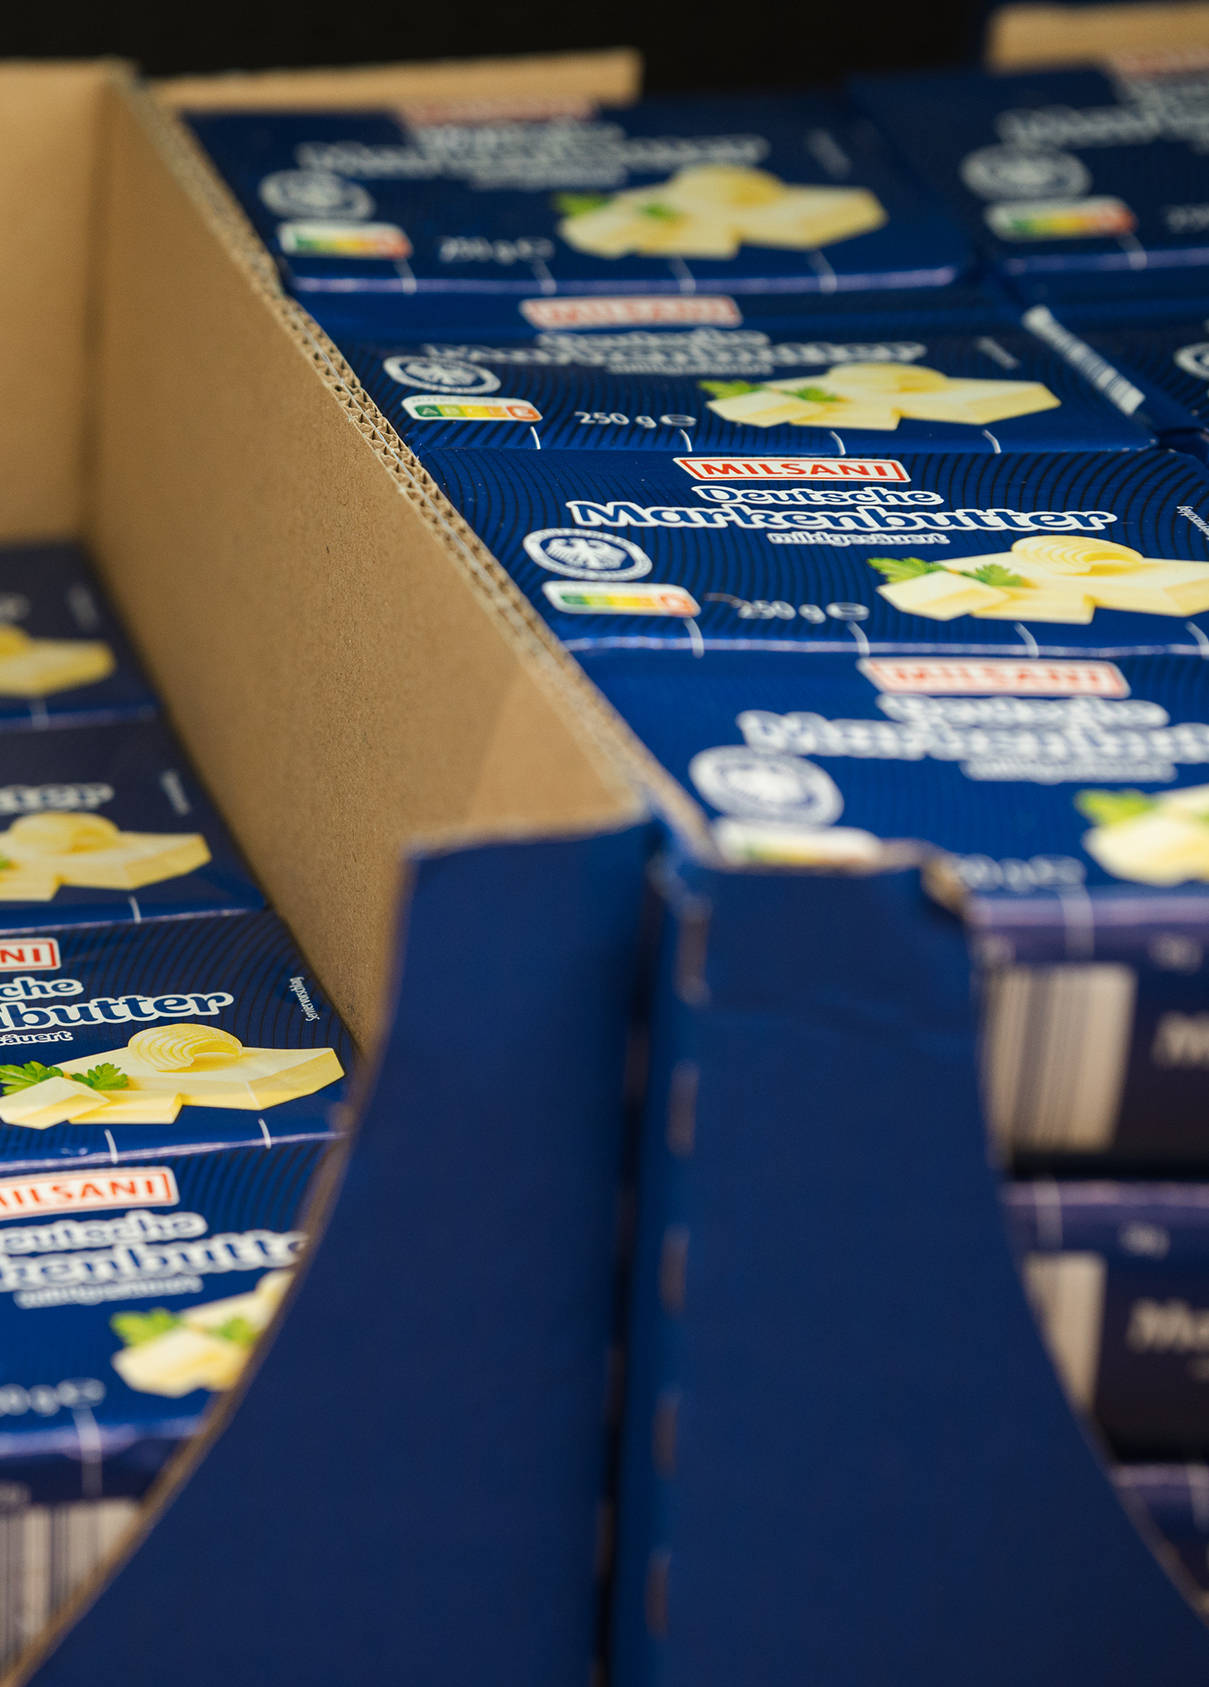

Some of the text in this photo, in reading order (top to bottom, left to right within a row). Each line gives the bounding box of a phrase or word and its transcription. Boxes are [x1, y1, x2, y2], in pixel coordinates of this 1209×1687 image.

[698, 460, 890, 481] MILSANI
[692, 485, 944, 507] Deutsche
[566, 499, 1118, 533] Markenbutter
